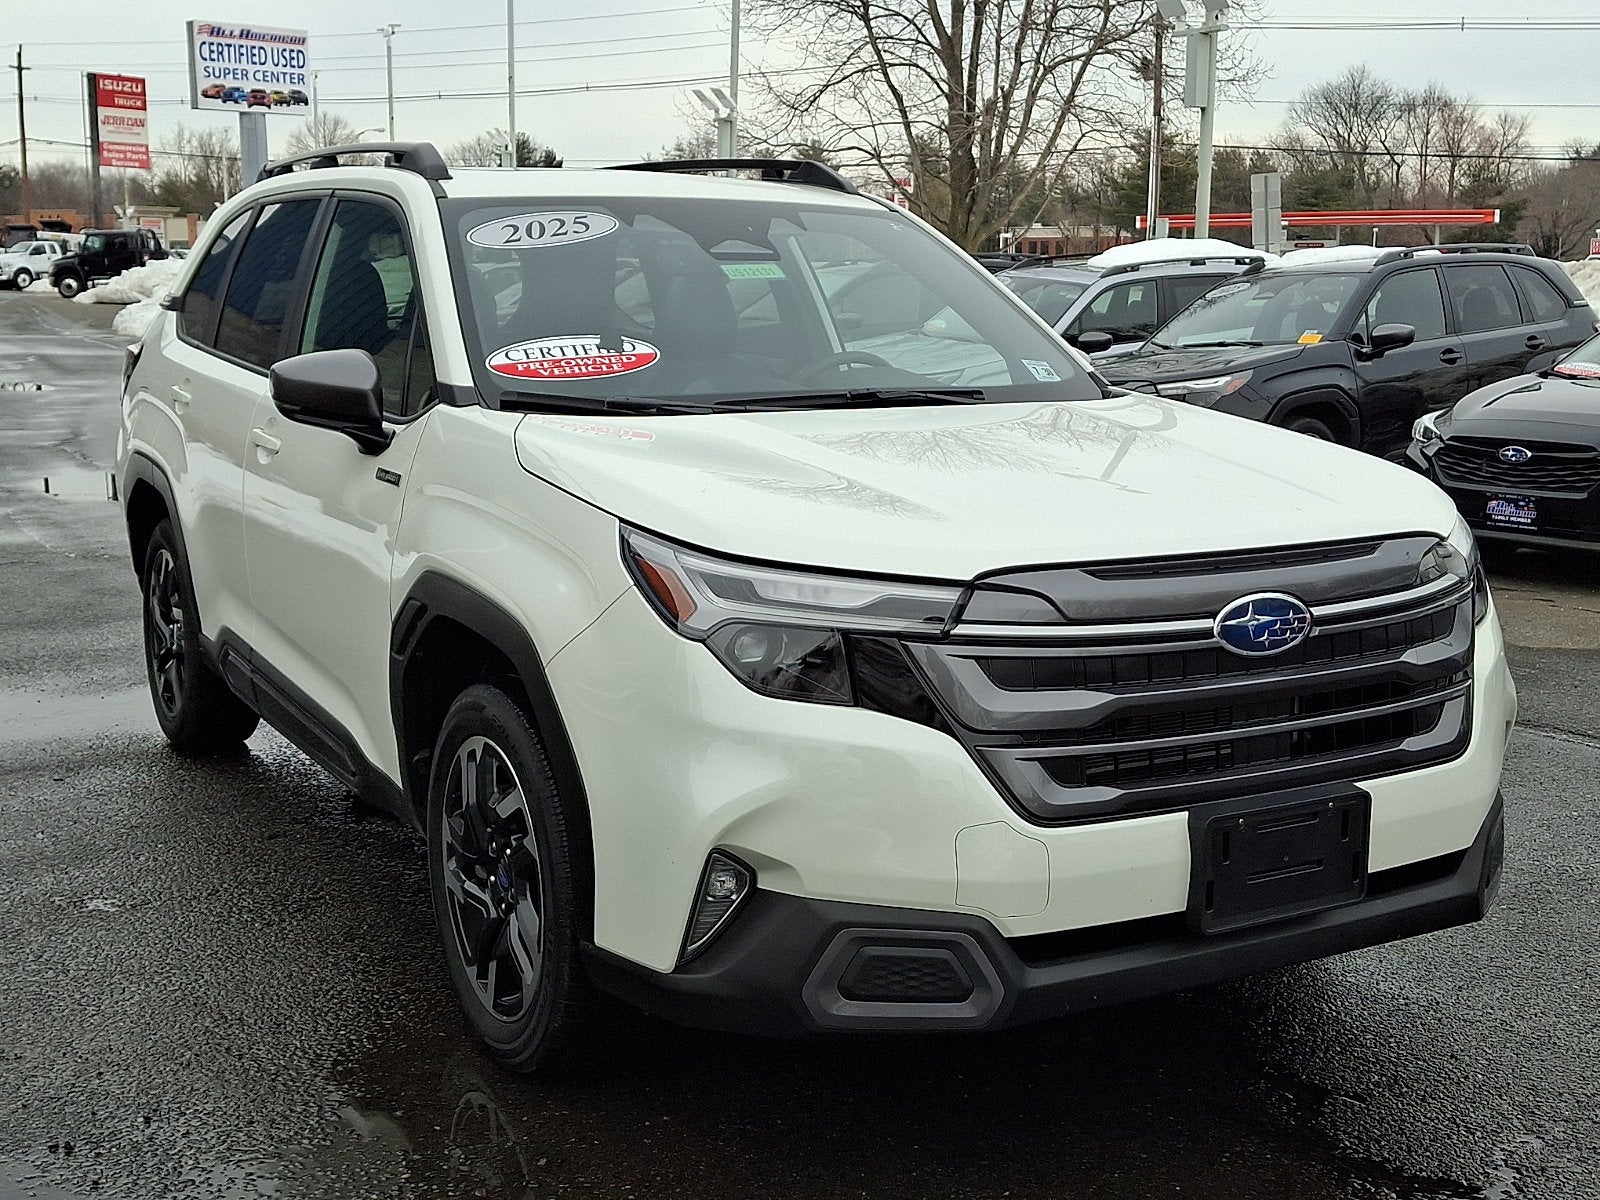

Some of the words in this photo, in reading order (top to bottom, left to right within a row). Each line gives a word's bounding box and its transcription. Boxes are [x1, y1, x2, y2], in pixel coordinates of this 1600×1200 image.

[199, 41, 268, 66] CERTIFIED
[270, 47, 306, 69] USED
[203, 65, 249, 81] SUPER
[252, 69, 306, 85] CENTER
[99, 79, 142, 93] ISUZU
[114, 97, 143, 107] TRUCK
[500, 215, 591, 244] 2025
[504, 341, 637, 362] CERTIFID
[516, 354, 637, 371] PRE-OWNED
[536, 362, 625, 376] VEHICLE
